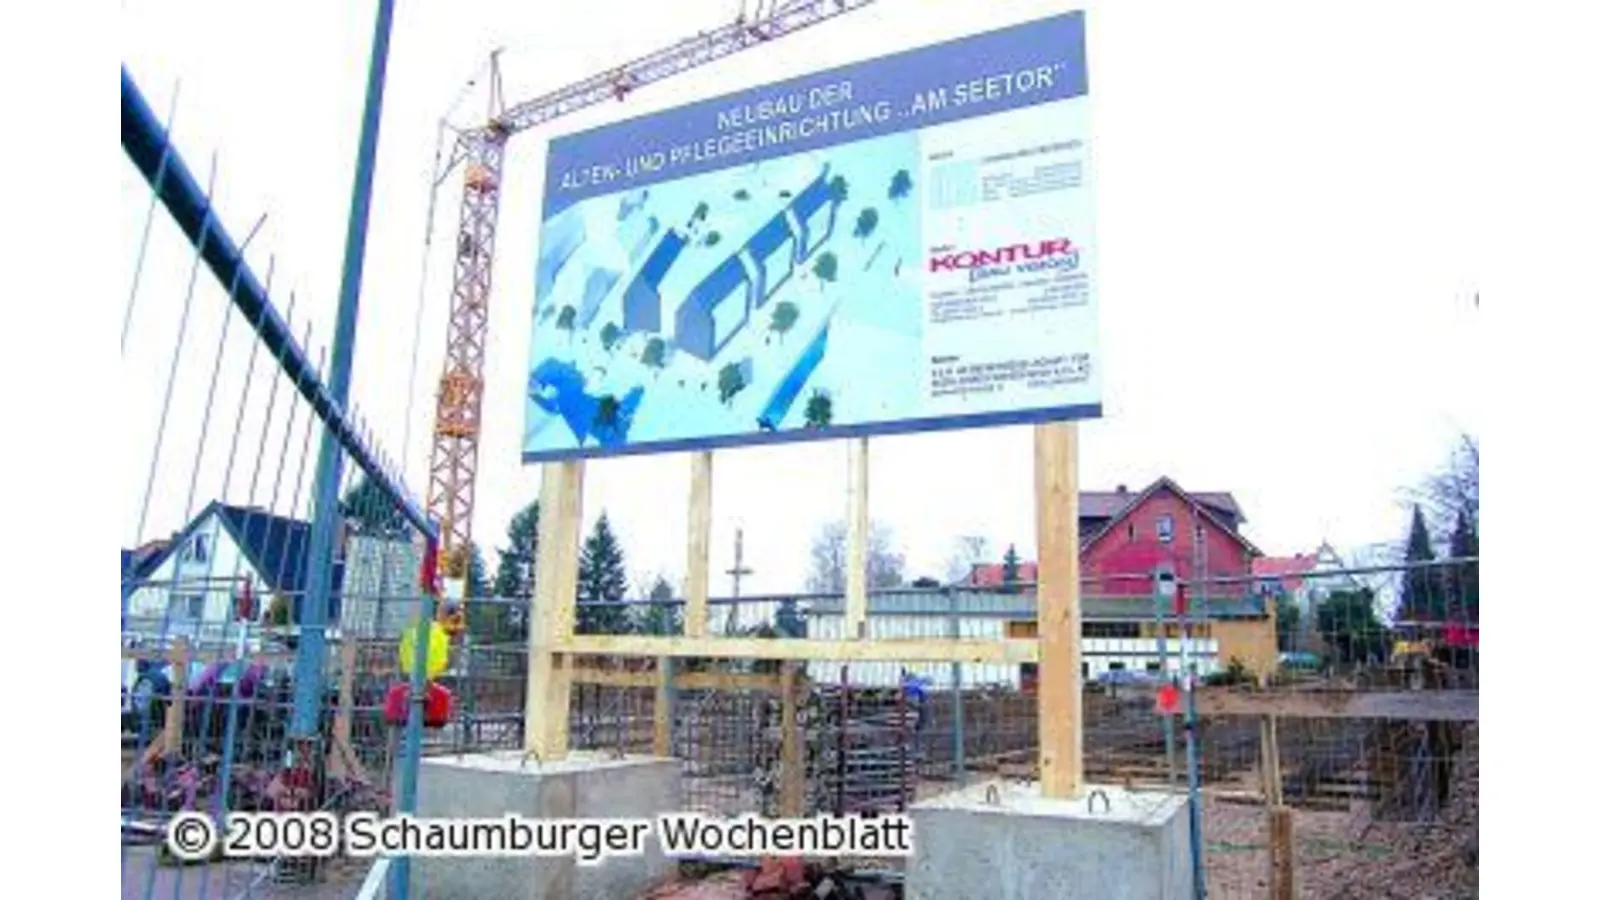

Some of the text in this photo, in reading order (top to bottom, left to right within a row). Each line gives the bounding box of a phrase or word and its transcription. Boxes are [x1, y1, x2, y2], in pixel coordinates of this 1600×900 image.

[717, 81, 852, 131] NEUBAU DER
[559, 164, 621, 190] ALTEN-
[626, 152, 665, 178] UND
[670, 101, 892, 166] PFLEGEEINRICHTUNG
[930, 237, 1071, 272] KONTUR
